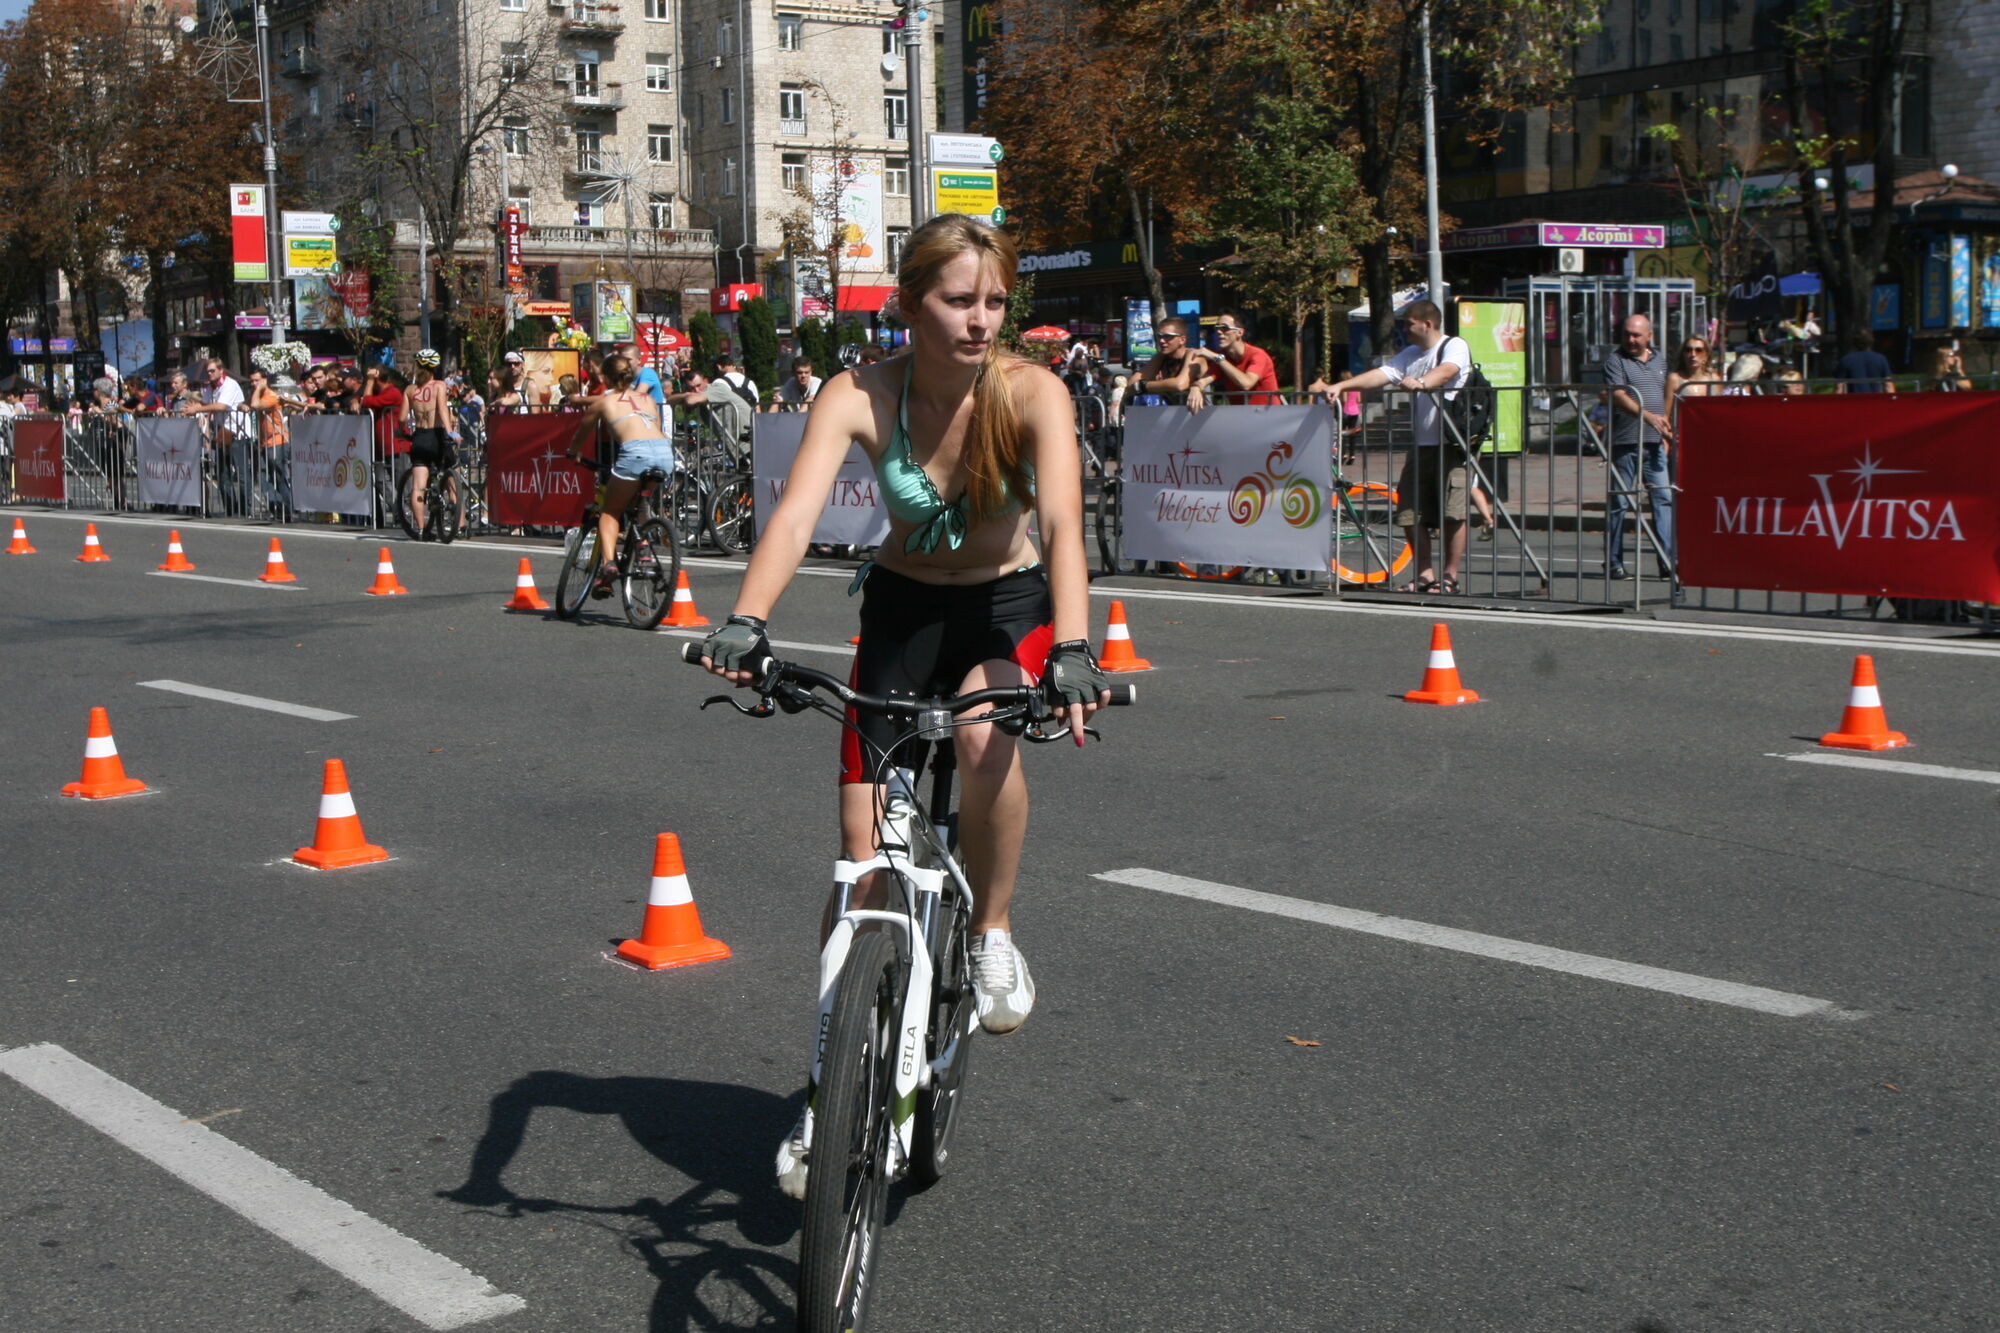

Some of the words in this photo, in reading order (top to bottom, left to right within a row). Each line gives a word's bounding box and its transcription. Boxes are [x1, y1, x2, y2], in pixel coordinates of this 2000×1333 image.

[1018, 250, 1091, 273] cDonald's
[19, 450, 56, 479] MILAVITSA
[145, 452, 192, 483] MILAVITSA
[500, 458, 581, 501] MILAVITSA
[1131, 453, 1223, 489] MILAVITSA
[1154, 491, 1222, 532] Velofest
[1713, 474, 1966, 550] MILAVITSA
[901, 1025, 918, 1077] GILA
